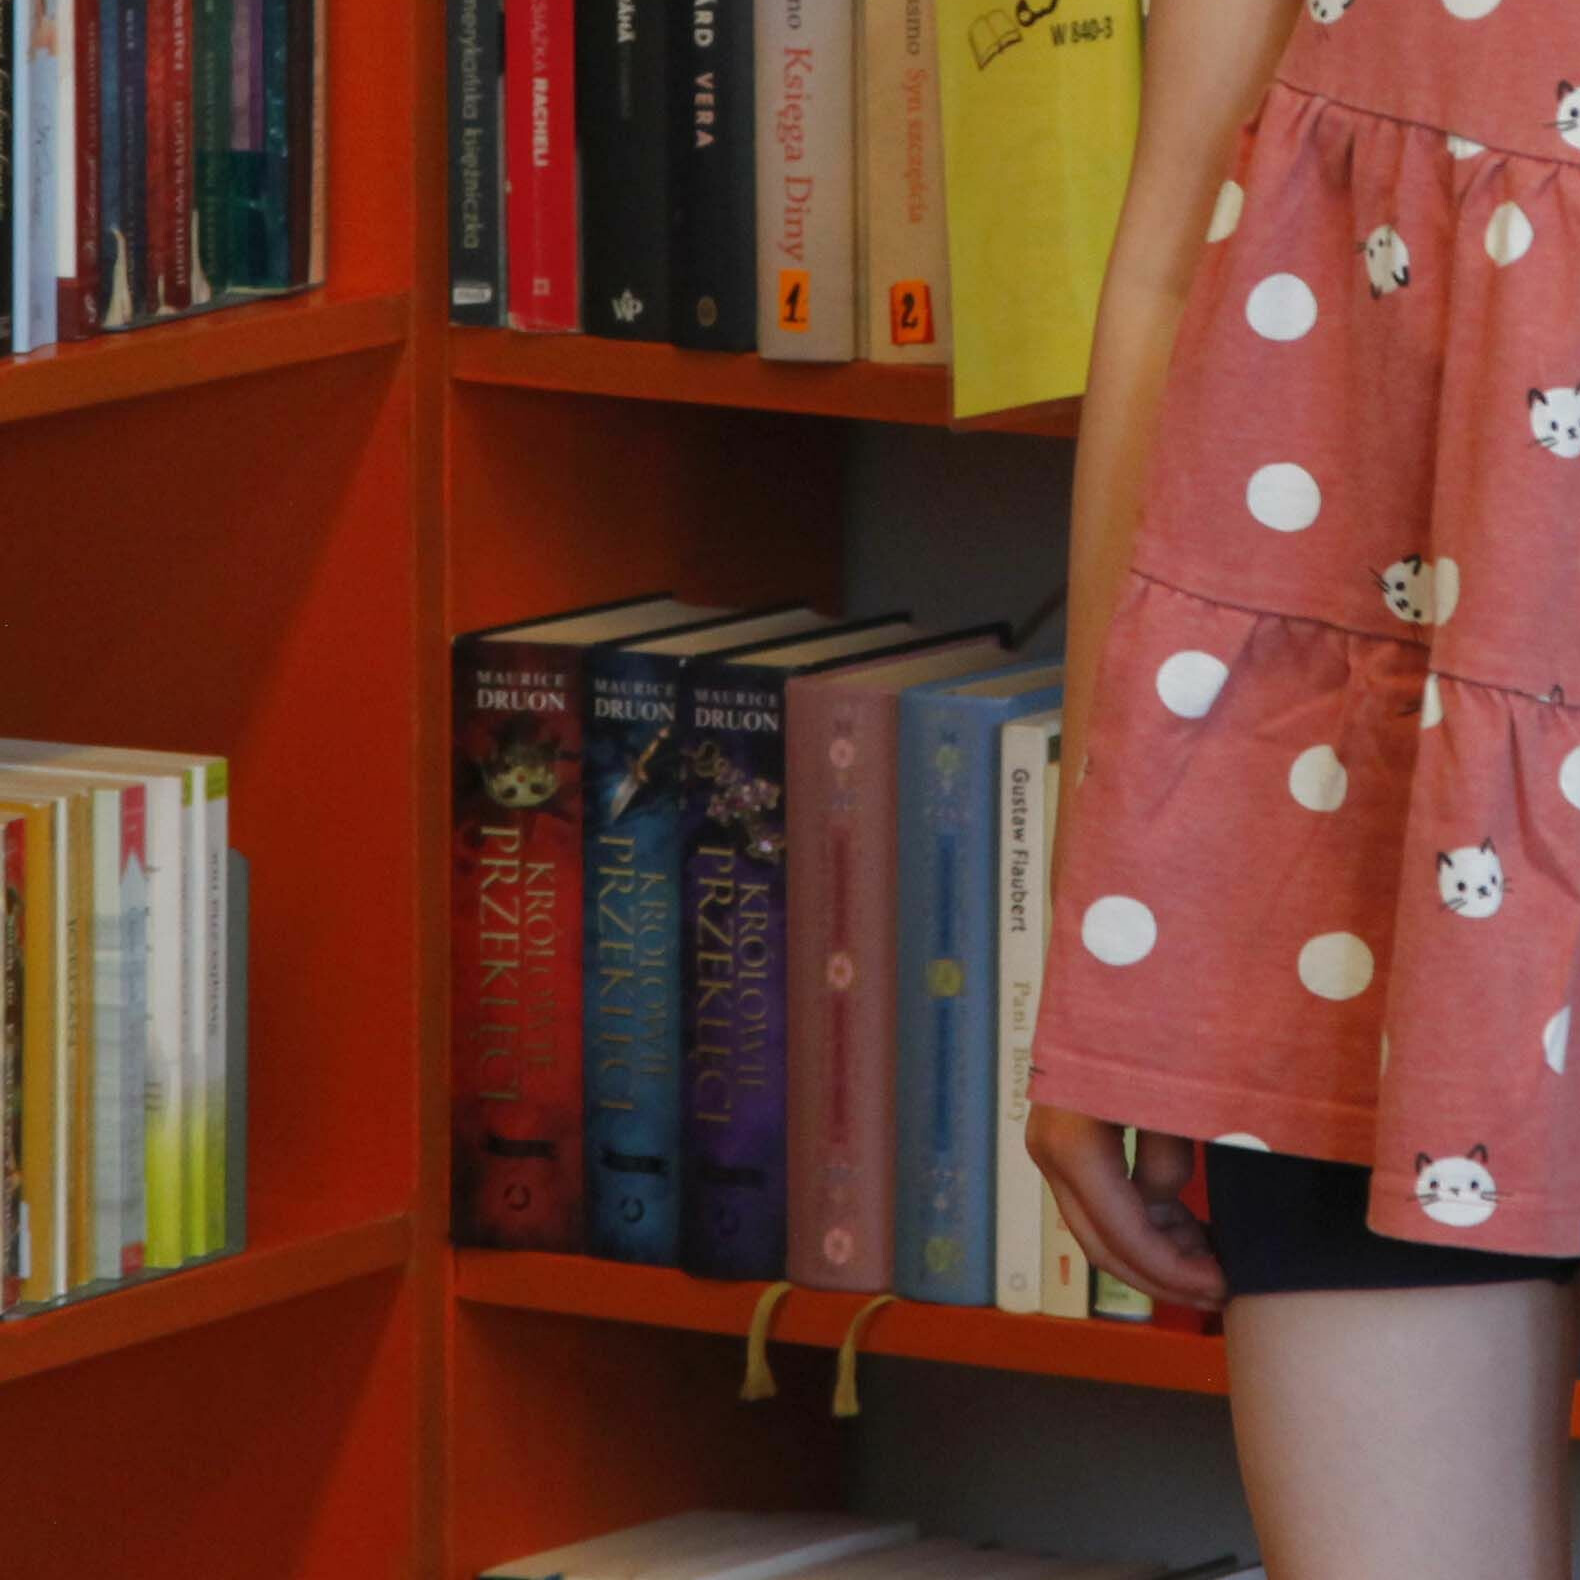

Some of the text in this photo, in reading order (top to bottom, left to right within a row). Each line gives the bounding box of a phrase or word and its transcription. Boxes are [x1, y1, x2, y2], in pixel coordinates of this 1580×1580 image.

[1051, 24, 1069, 47] W
[532, 77, 550, 168] RACHELI
[694, 72, 715, 149] VERA
[776, 47, 813, 163] Księga
[778, 176, 813, 263] Diny
[784, 283, 807, 323] 1
[900, 292, 918, 330] 2
[477, 689, 566, 711] DRUON
[594, 698, 676, 721] DRUON
[694, 707, 779, 732] DRUON
[1009, 768, 1031, 934] Gustaw Flaubert
[1012, 980, 1032, 1032] Pani
